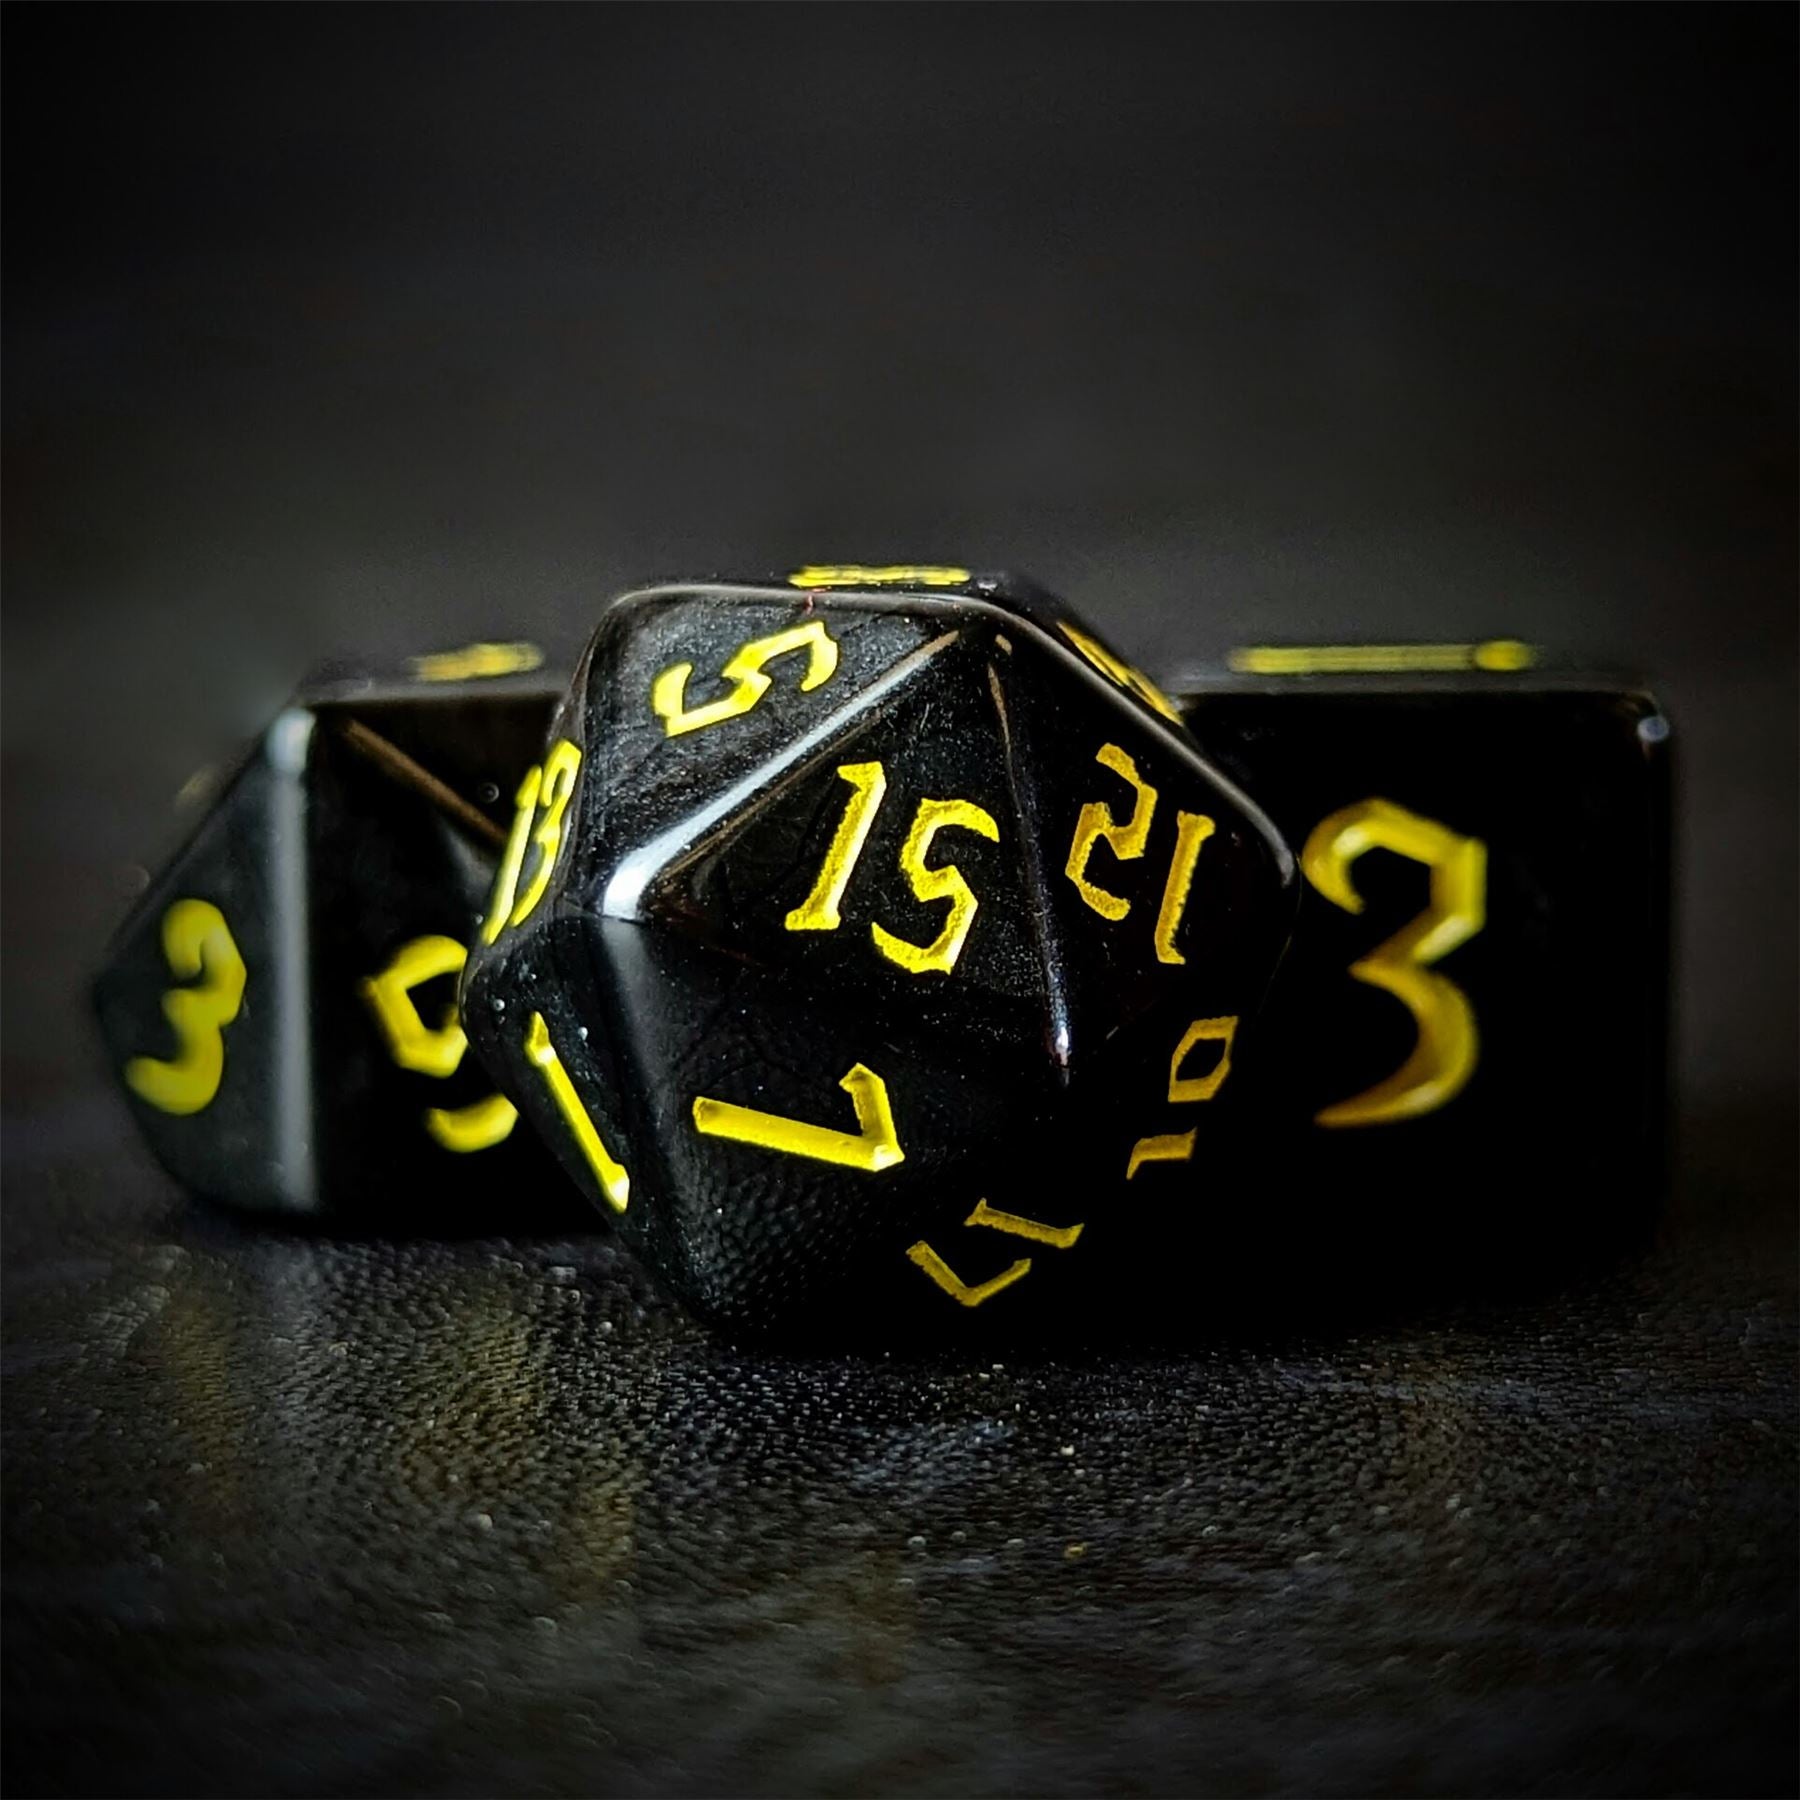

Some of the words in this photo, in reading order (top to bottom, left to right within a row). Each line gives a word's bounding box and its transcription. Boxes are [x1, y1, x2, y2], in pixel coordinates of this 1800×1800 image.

[652, 621, 839, 736] 5
[480, 738, 583, 945] 13
[785, 761, 999, 974] 15
[128, 898, 248, 1115] 3
[1302, 799, 1487, 1126] 3
[525, 1011, 629, 1213] 1
[692, 1063, 905, 1172] 7
